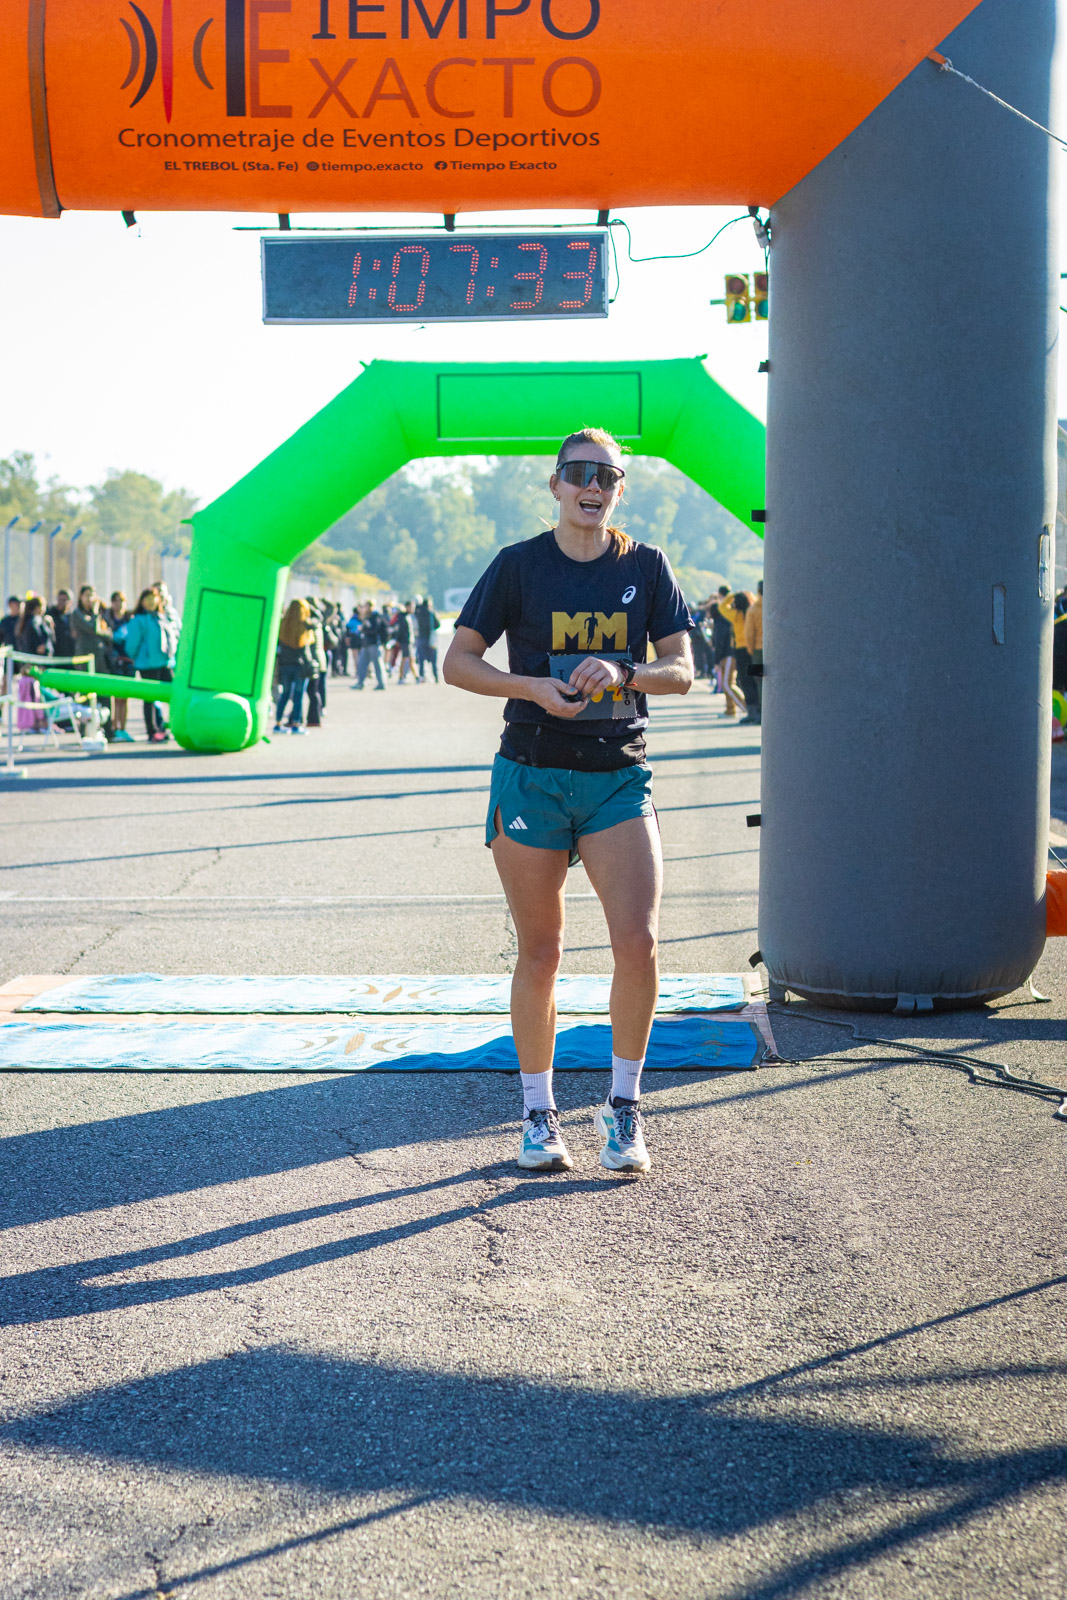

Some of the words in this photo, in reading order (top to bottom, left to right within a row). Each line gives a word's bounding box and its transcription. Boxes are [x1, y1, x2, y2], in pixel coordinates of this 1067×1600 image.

[118, 128, 294, 152] Cronometraje
[302, 128, 334, 147] de
[343, 128, 446, 147] Eventos
[454, 128, 600, 151] Deportivos
[164, 161, 182, 171] EL
[183, 161, 240, 171] TREBOL
[242, 161, 275, 172] (Sta.
[278, 161, 299, 172] Fe)
[322, 161, 424, 173] tiempo.exacto
[450, 161, 506, 172] Tiempo
[509, 161, 557, 171] Exacto
[349, 242, 597, 311] 1:07:33
